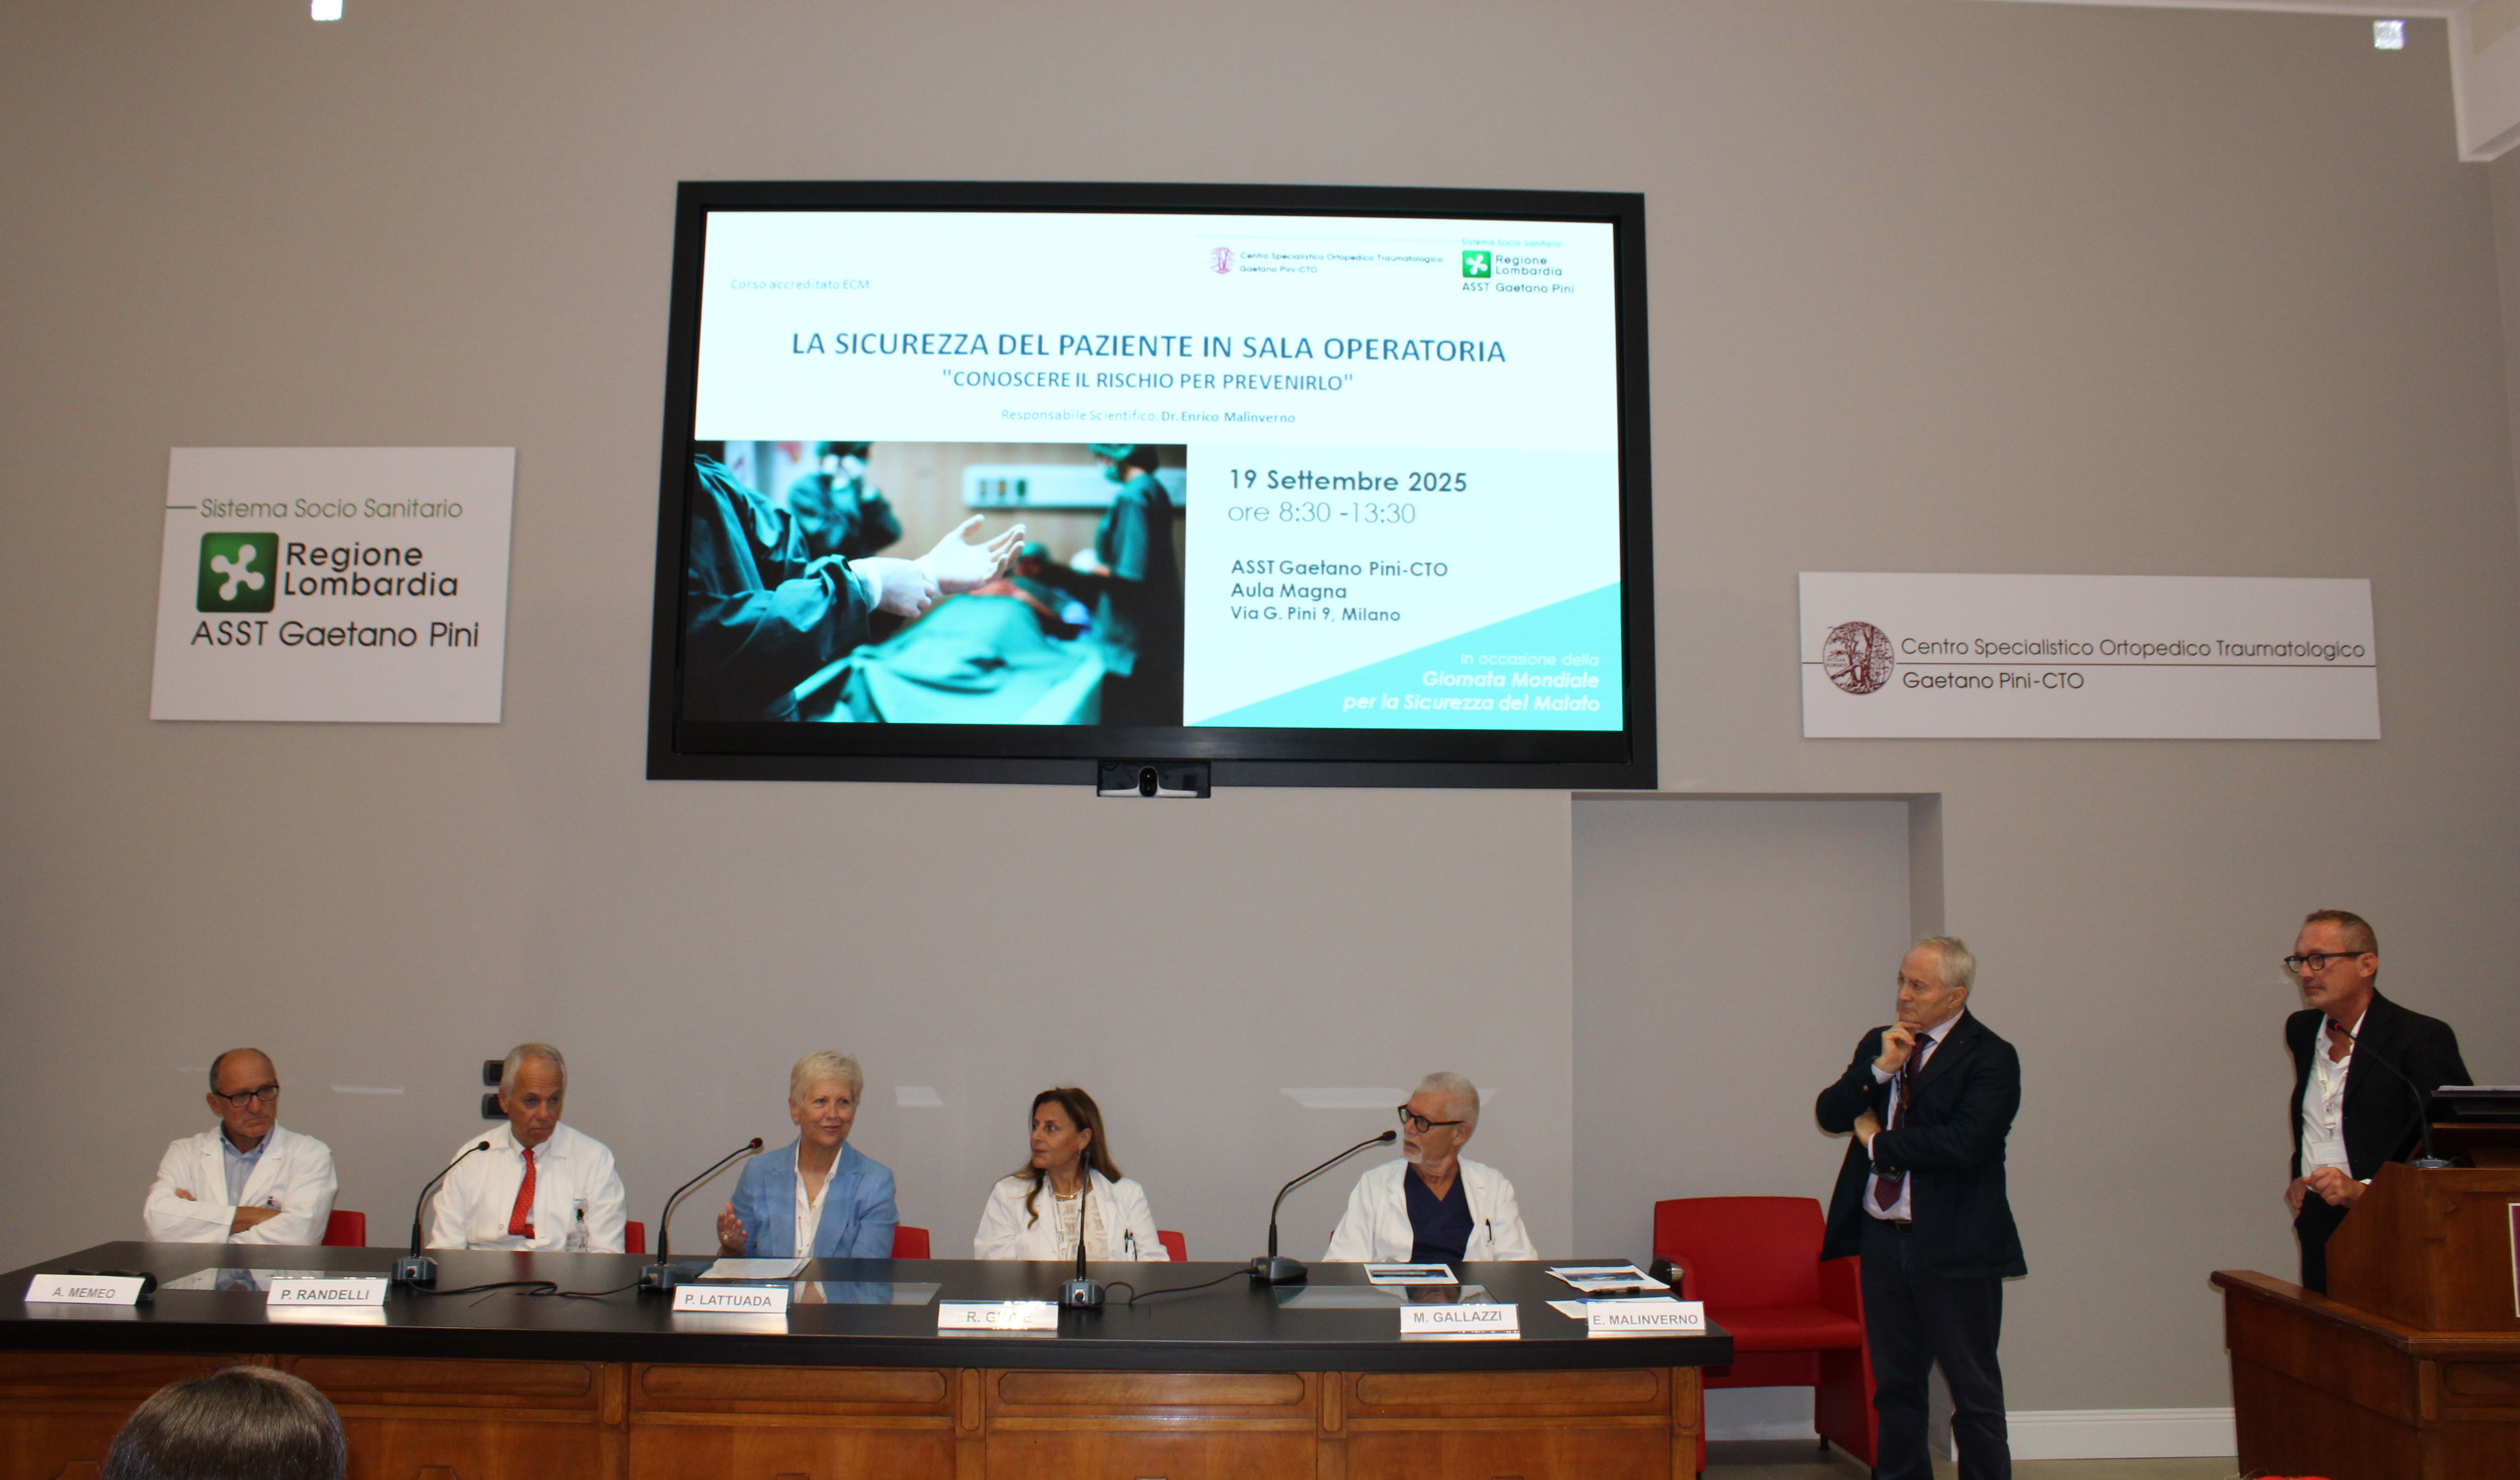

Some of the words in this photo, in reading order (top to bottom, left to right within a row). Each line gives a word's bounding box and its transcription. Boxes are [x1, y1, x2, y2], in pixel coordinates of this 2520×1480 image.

[1377, 254, 1443, 264] Traumatologico
[1496, 255, 1547, 267] Regione
[1496, 266, 1562, 276] Lombardia
[731, 279, 767, 289] Corso
[769, 279, 840, 289] accreditato
[843, 280, 870, 289] ECM
[1462, 282, 1489, 291] ASST
[1495, 283, 1548, 293] Gaetano
[1552, 284, 1574, 293] Pini
[793, 333, 825, 354] LA
[836, 333, 989, 355] SICUREZZA
[999, 334, 1049, 355] DEL
[1060, 334, 1192, 357] PAZIENTE
[1203, 336, 1231, 357] IN
[1243, 337, 1313, 359] SALA
[1324, 338, 1506, 362] OPERATORIA
[943, 369, 1070, 387] "CONOSCERE
[1076, 373, 1089, 387] IL
[1097, 373, 1174, 388] RISCHIO
[1180, 373, 1215, 389] PER
[1223, 374, 1352, 391] PREVENIRLO"
[1002, 409, 1087, 421] Responsabile
[1161, 411, 1178, 421] Dr.
[1181, 411, 1219, 422] Enrico
[1224, 412, 1295, 423] Malinverno
[1231, 469, 1257, 489] 19
[1267, 469, 1399, 491] Settembre
[1409, 472, 1467, 492] 2025
[201, 498, 288, 518] Sistema
[294, 498, 357, 518] Socio
[364, 498, 463, 518] Sanitario
[1228, 506, 1270, 522] ore
[1279, 501, 1331, 522] 8:30
[286, 542, 423, 573] Regione
[1231, 560, 1275, 574] ASST
[1279, 559, 1362, 576] Gaetano
[1370, 560, 1448, 577] Pini-CTO
[284, 571, 457, 596] Lombardia
[1231, 582, 1274, 598] Aula
[1280, 583, 1346, 602] Magna
[1231, 606, 1259, 620] Via
[1263, 606, 1282, 620] G.
[1288, 606, 1316, 620] Pini
[1322, 607, 1335, 623] 9,
[1342, 607, 1401, 621] Milano
[190, 620, 269, 646] ASST
[279, 620, 417, 647] Gaetano
[430, 622, 479, 647] Pini
[1901, 638, 1969, 655] Centro
[1975, 638, 2094, 658] Specialistico
[2100, 639, 2211, 659] Ortopedico
[2216, 640, 2365, 662] Traumatologico
[1460, 653, 1474, 664] In
[1478, 652, 1557, 666] occasione
[1562, 653, 1600, 666] della
[1423, 670, 1506, 687] Giornata
[1511, 671, 1600, 689] Mondiale
[1903, 671, 1994, 689] Gaetano
[1999, 672, 2084, 689] Pini-CTO
[1343, 696, 1377, 712] per
[1381, 693, 1399, 709] la
[1404, 694, 1494, 710] Sicurezza
[1498, 694, 1529, 711] del
[1534, 694, 1600, 712] Malato
[52, 1287, 64, 1297] A.
[68, 1287, 115, 1299] MEMEO
[281, 1289, 291, 1300] P.
[296, 1289, 369, 1300] RANDELLI
[685, 1294, 695, 1304] P.
[700, 1295, 772, 1306] LATTUADA
[967, 1311, 980, 1322] R.
[1414, 1312, 1428, 1323] M.
[1433, 1311, 1502, 1323] GALLAZZI
[1593, 1315, 1605, 1325] E.
[1609, 1314, 1698, 1325] MALINVERNO
